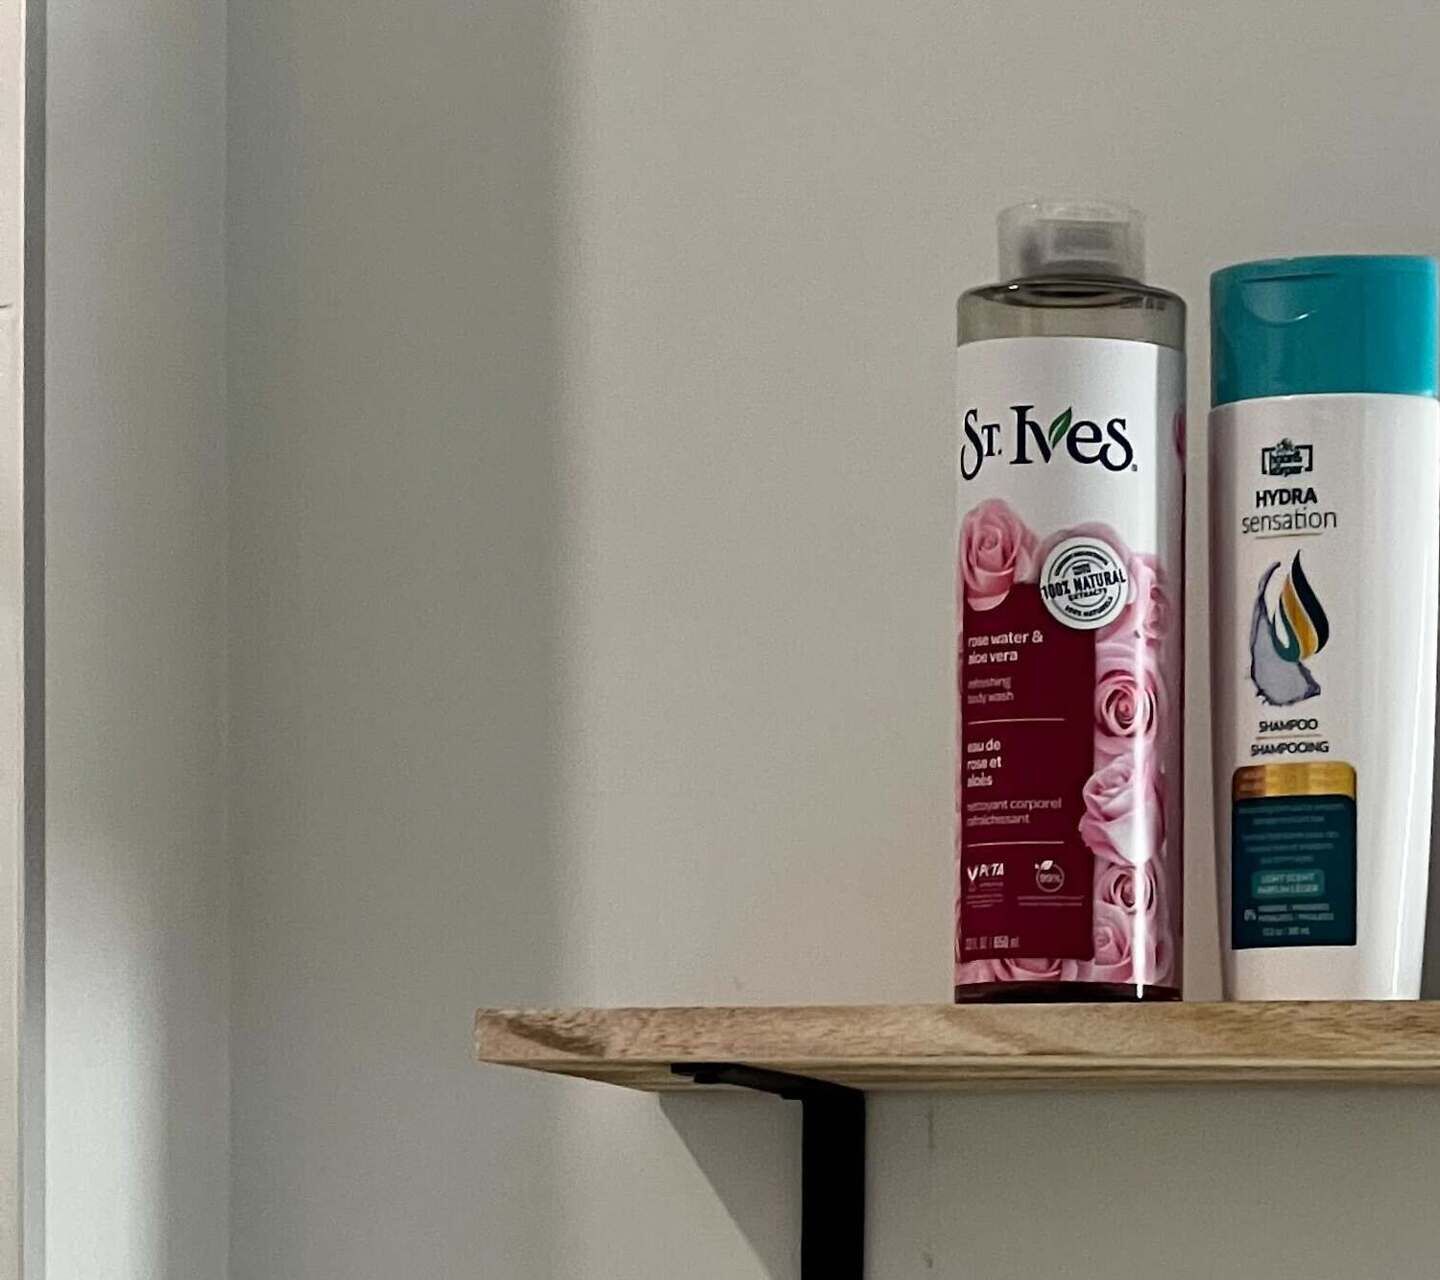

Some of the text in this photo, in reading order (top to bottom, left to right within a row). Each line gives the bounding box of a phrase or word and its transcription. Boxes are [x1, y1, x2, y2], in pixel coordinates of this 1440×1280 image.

[1255, 487, 1318, 508] HYDRA
[1242, 506, 1337, 534] sensation
[1073, 568, 1127, 591] NATURAL
[968, 630, 1043, 648] rose water &
[968, 650, 1018, 665] aloe vera
[1259, 718, 1319, 733] SHAMPOO
[985, 738, 1001, 751] de
[1251, 741, 1330, 757] SHAMPOOING
[967, 755, 1002, 770] rose et
[1010, 797, 1062, 811] corporel
